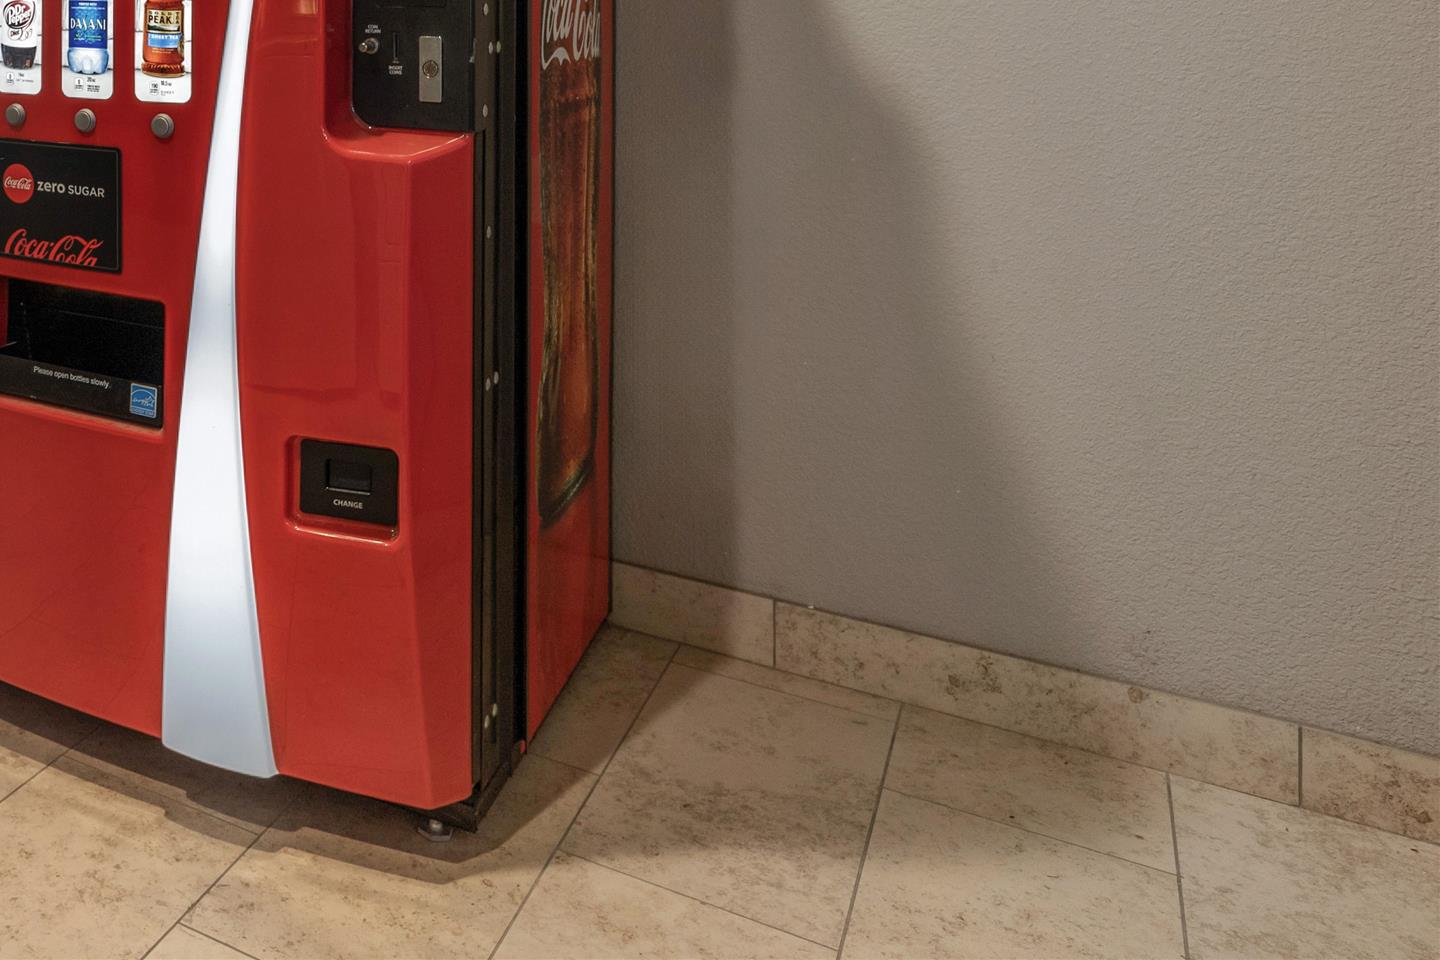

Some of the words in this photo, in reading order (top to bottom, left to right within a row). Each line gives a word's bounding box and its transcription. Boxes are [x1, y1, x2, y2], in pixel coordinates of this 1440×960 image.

[70, 17, 106, 31] DASANI
[148, 14, 172, 25] PEAK
[4, 176, 32, 190] Coca-Cola
[37, 181, 66, 193] zero
[67, 184, 105, 198] SUGAR
[33, 365, 53, 376] Please
[53, 371, 69, 379] open
[69, 373, 90, 384] bottles
[332, 499, 364, 510] CHANGE
